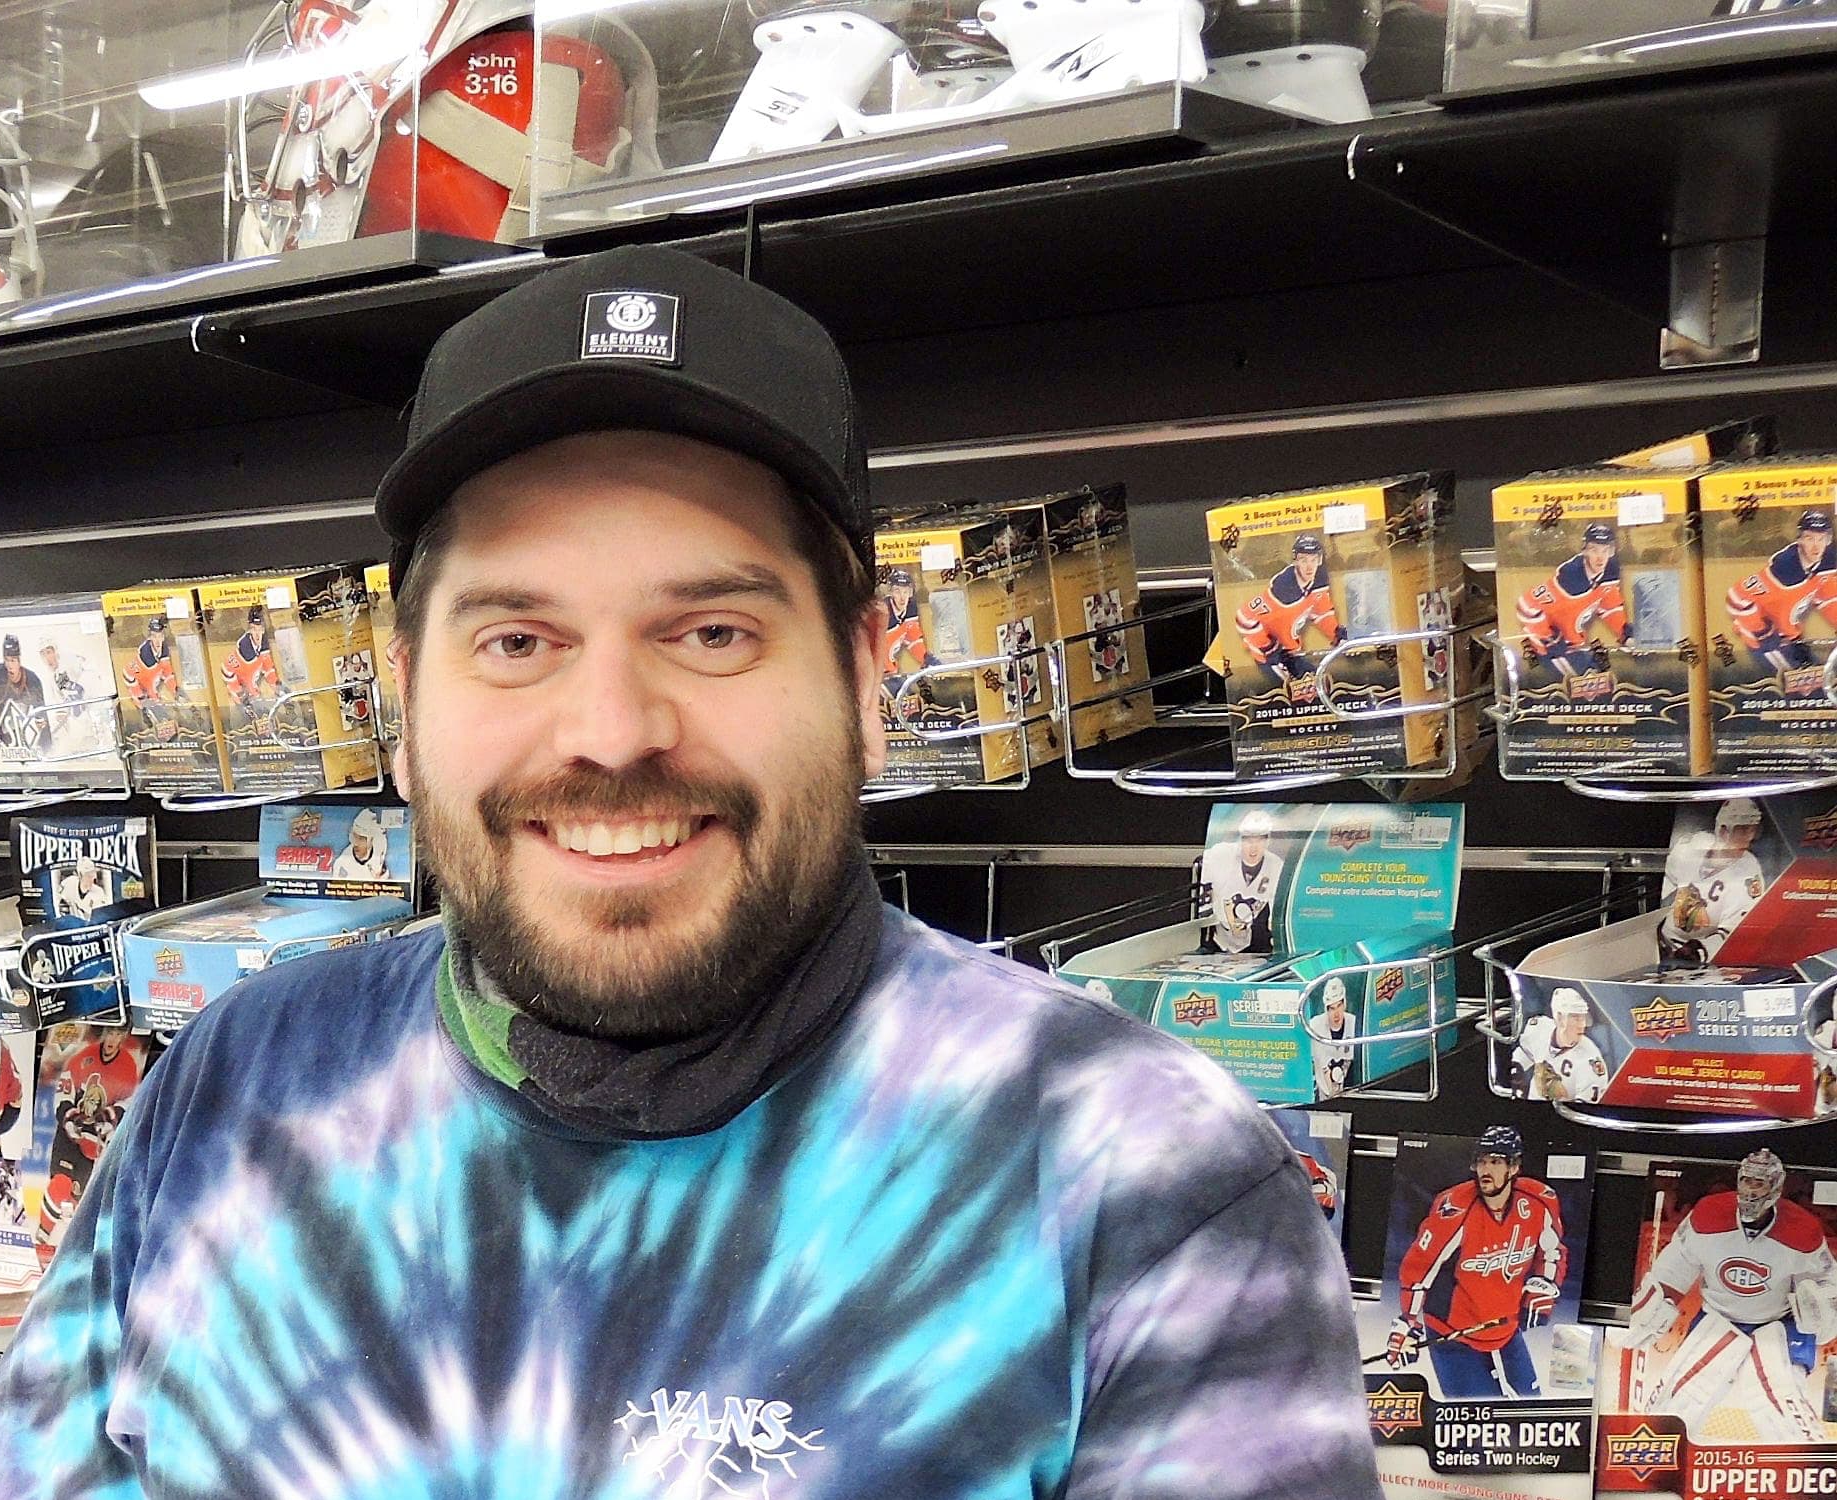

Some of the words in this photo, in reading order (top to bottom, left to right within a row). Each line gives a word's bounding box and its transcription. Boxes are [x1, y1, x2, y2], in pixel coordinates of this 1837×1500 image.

[467, 53, 518, 72] john
[465, 72, 519, 95] 3:16
[589, 333, 670, 347] ELEMENT
[20, 822, 83, 874] UPPER
[88, 831, 144, 878] DECK
[1320, 873, 1346, 883] YOUNG
[51, 942, 103, 977] UPPER
[1175, 1001, 1216, 1012] UPPER
[1635, 1009, 1684, 1022] UPPER
[1698, 1024, 1738, 1037] SERIES
[1742, 1025, 1748, 1037] 1
[1751, 1025, 1799, 1037] HOCKEY
[1692, 1058, 1725, 1068] COLLECT
[1517, 1197, 1531, 1219] C
[651, 1387, 793, 1450] VANS
[1435, 1406, 1491, 1422] 2015-16
[1434, 1422, 1512, 1449] UPPER
[1518, 1421, 1582, 1448] DECK
[1612, 1441, 1674, 1453] UPPER
[1435, 1450, 1480, 1466] Series
[1484, 1450, 1513, 1466] Two
[1515, 1452, 1561, 1469] Hockey
[1694, 1450, 1756, 1466] 2015-16
[1417, 1478, 1451, 1491] MORE
[1453, 1484, 1493, 1499] YOUNG
[1692, 1468, 1777, 1494] UPPER
[1785, 1467, 1837, 1495] DEC
